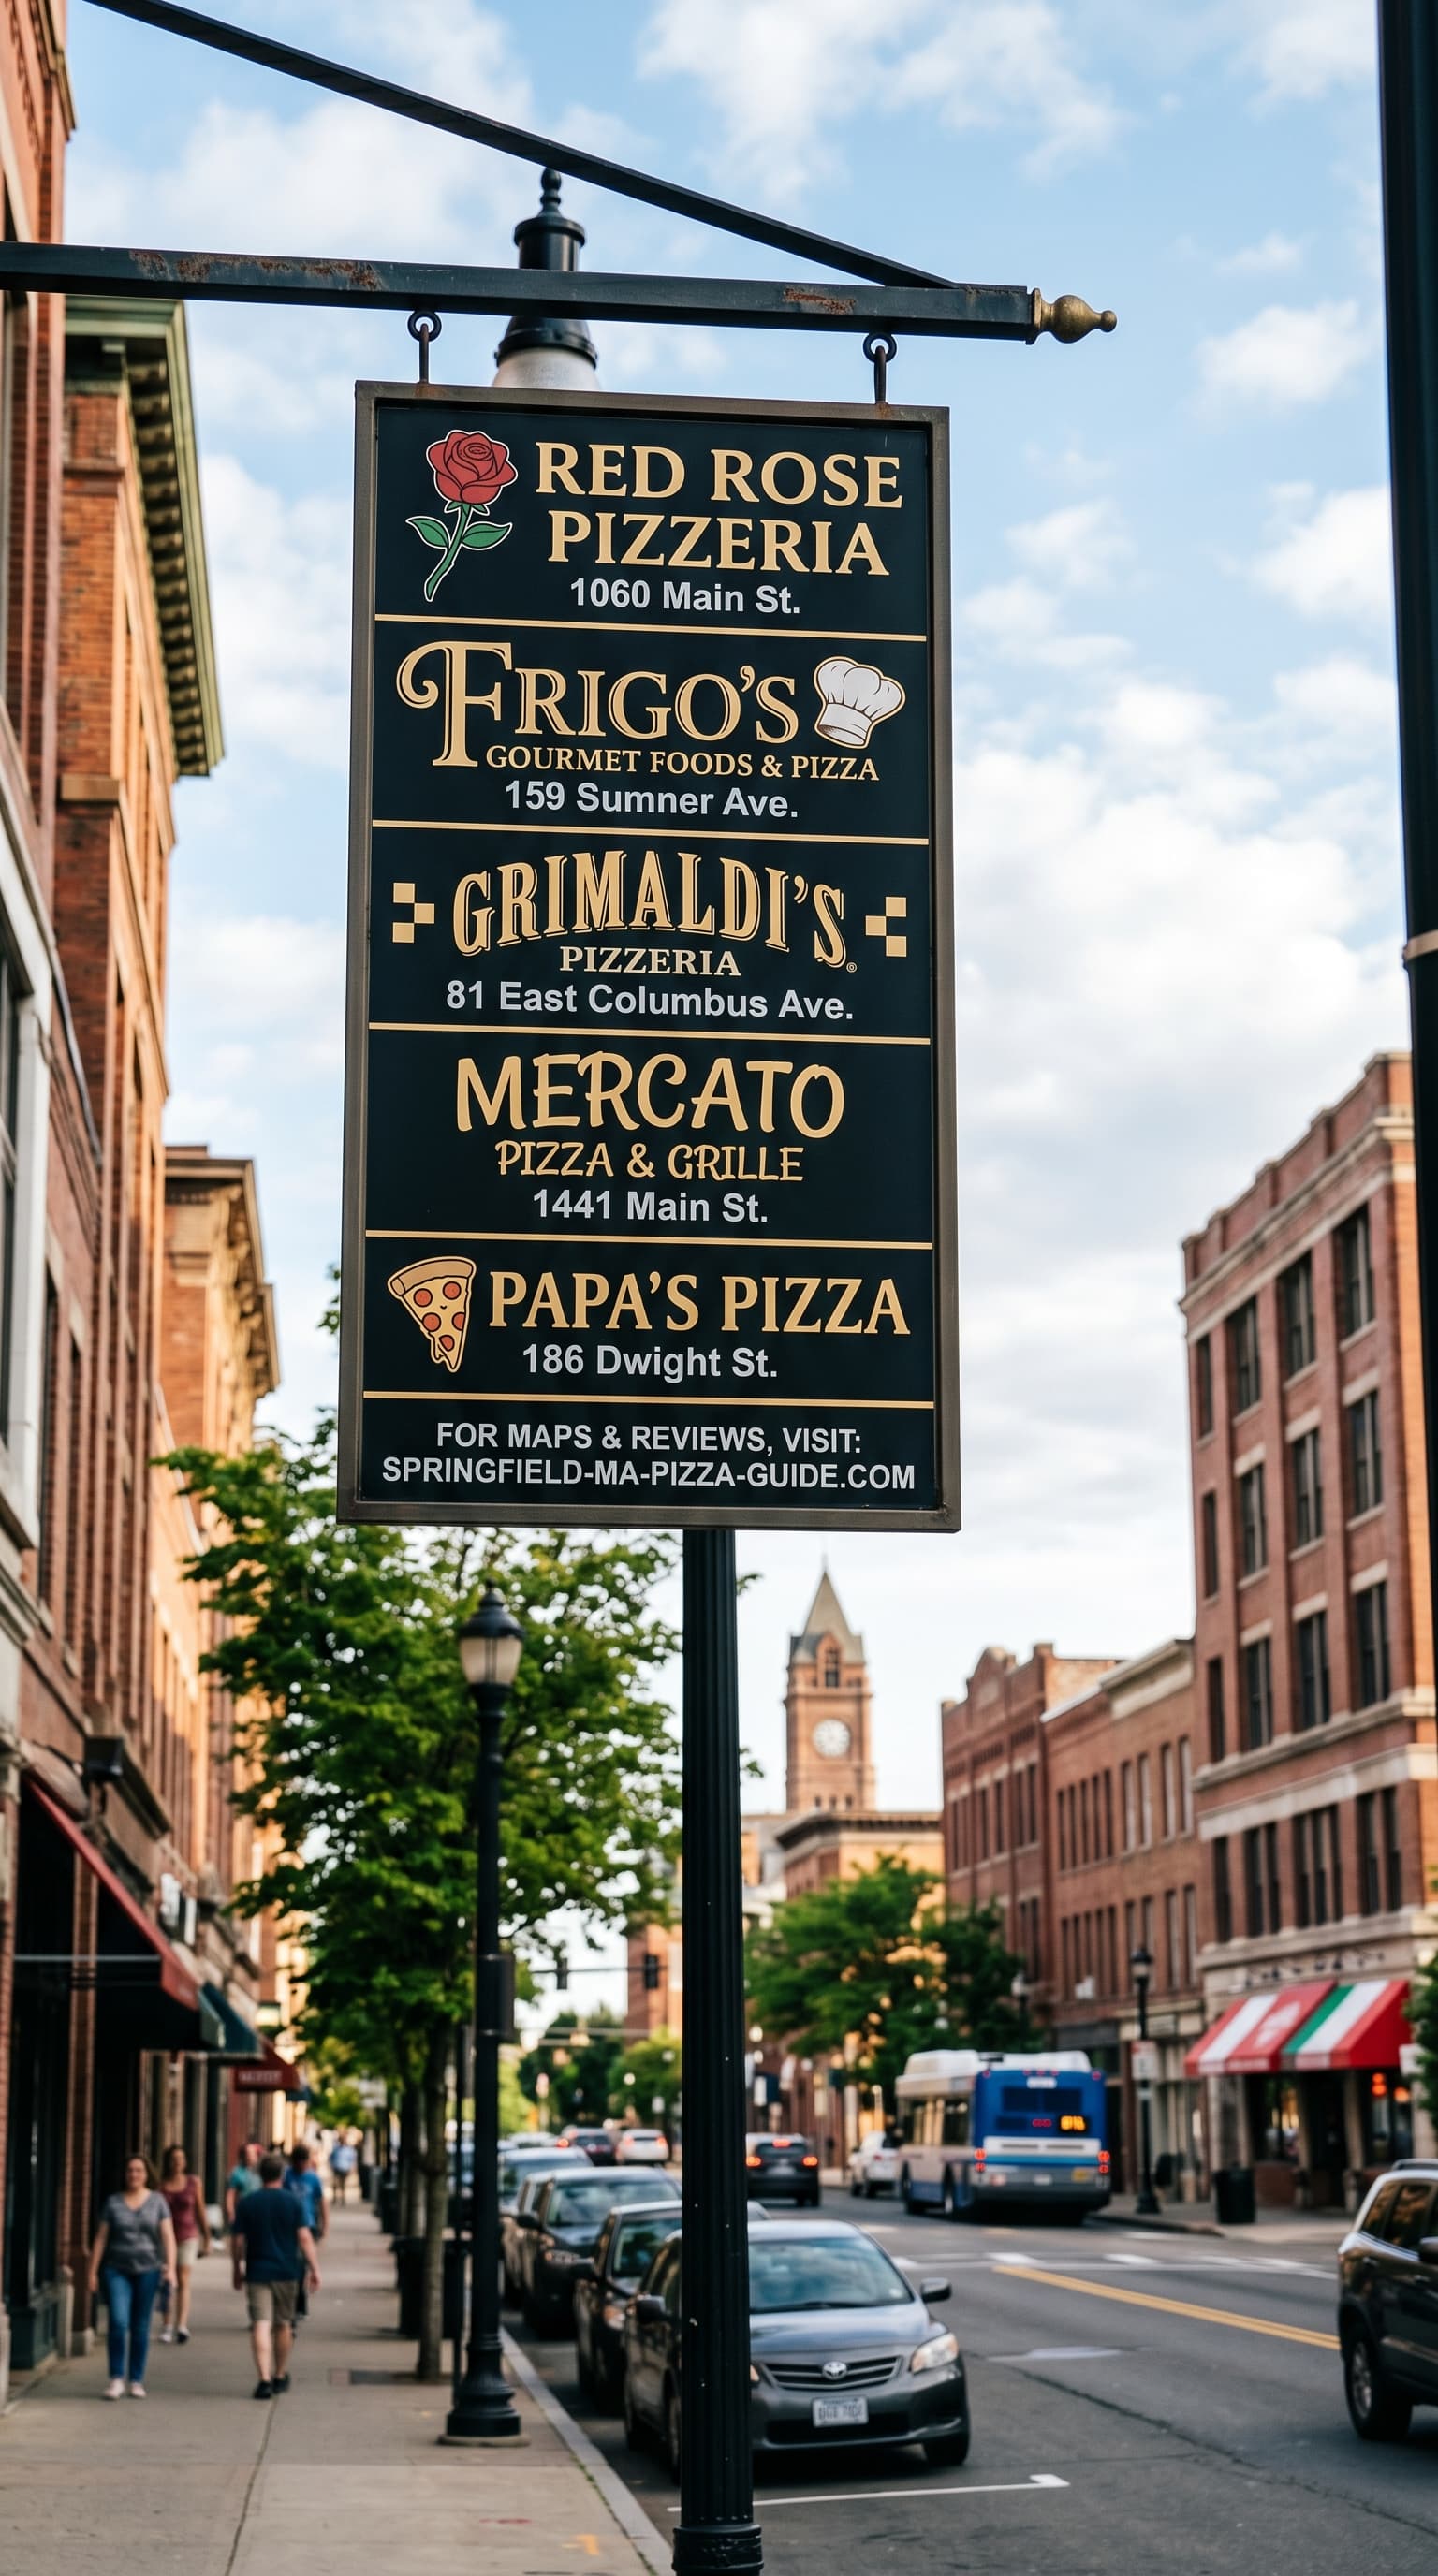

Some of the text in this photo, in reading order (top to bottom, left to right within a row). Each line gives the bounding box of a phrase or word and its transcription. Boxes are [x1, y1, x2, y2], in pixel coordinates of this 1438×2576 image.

[536, 442, 902, 508] RED ROSE
[549, 510, 889, 575] PIZZERIA
[571, 578, 800, 613] 1060 Main St.
[396, 641, 800, 767] FRIGO'S
[487, 746, 879, 780] GOURMET FOODS & PIZZA
[506, 781, 797, 817] 159 Sumner Ave.
[560, 946, 741, 975] PIZZERIA
[447, 980, 852, 1019] 81 East Columbus Ave.
[457, 1051, 844, 1138] MERCATO
[495, 1140, 803, 1180] PIZZA & GRILLE
[534, 1189, 767, 1222] 1441 Main St.
[490, 1272, 910, 1334] PAPA'S PIZZA
[523, 1344, 776, 1383] 186 Dwight St.
[438, 1423, 860, 1456] FOR MAPS & REVIEWS, VISIT:
[383, 1457, 914, 1489] SPRINGFIELD-MA-PIZZA-GUIDE.COM
